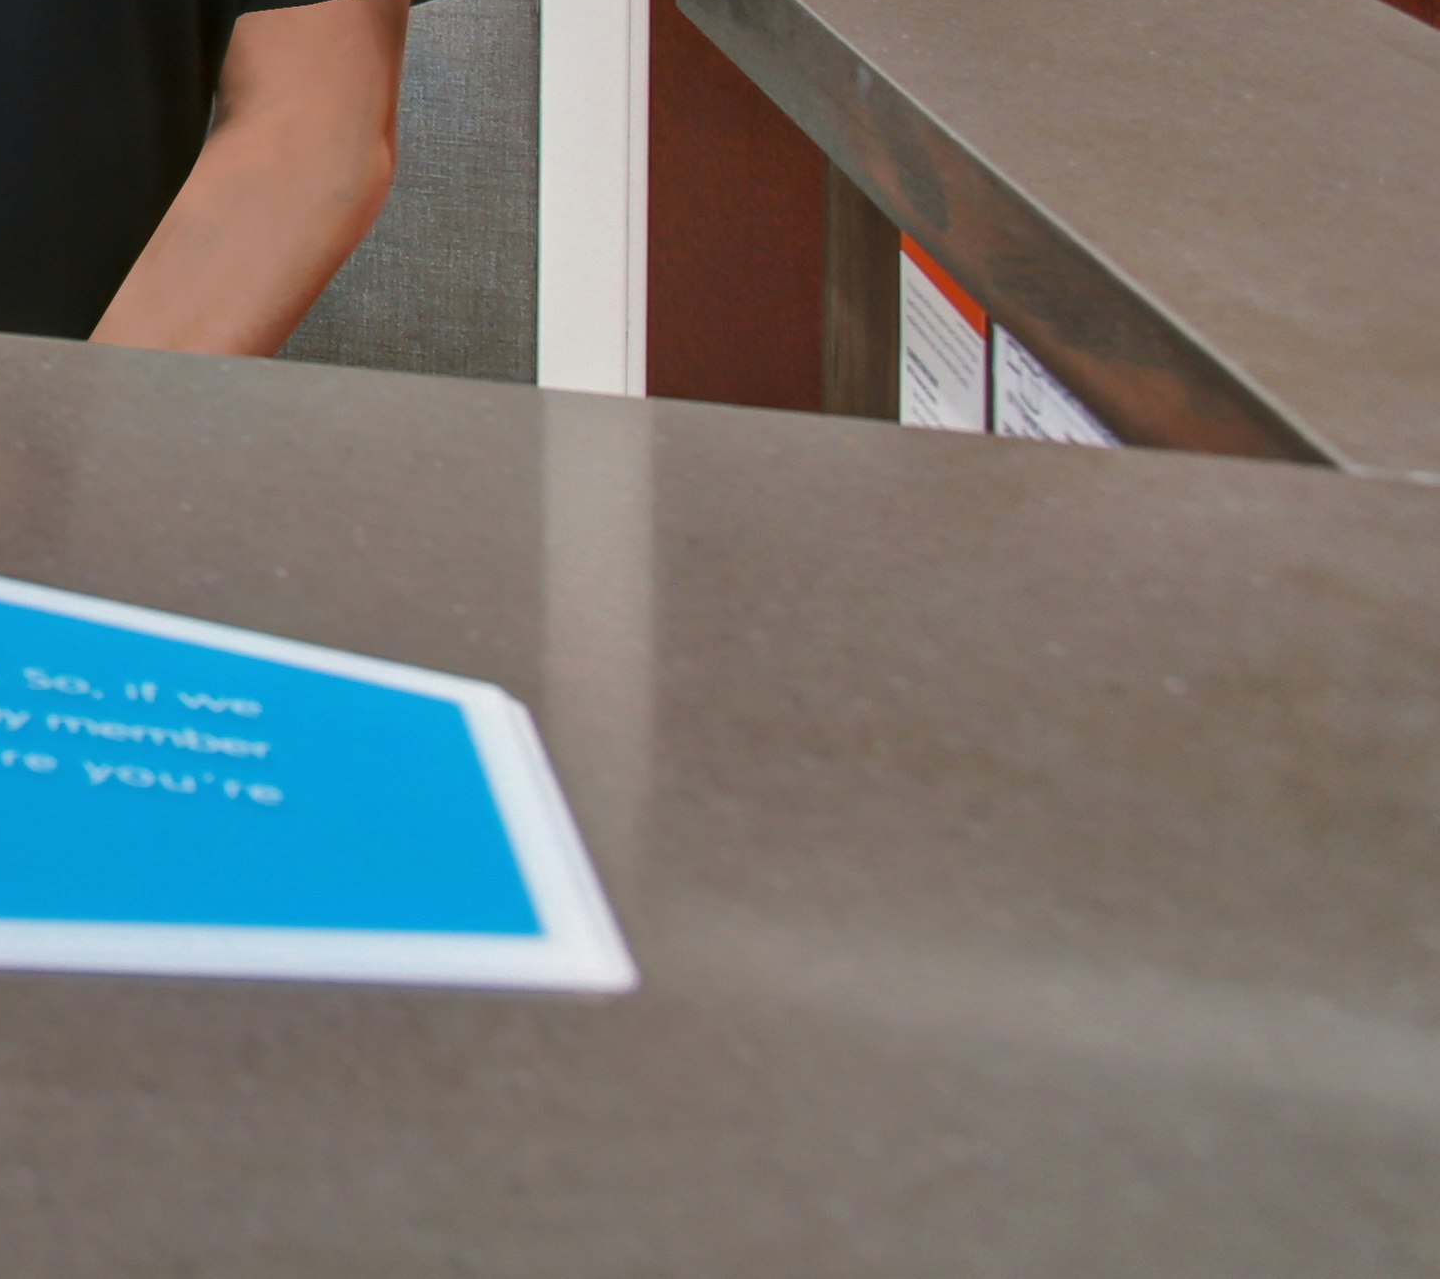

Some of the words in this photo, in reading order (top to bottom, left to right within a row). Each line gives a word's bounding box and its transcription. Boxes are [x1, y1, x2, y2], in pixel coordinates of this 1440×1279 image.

[124, 681, 158, 704] if
[176, 691, 264, 718] we
[46, 713, 271, 759] member
